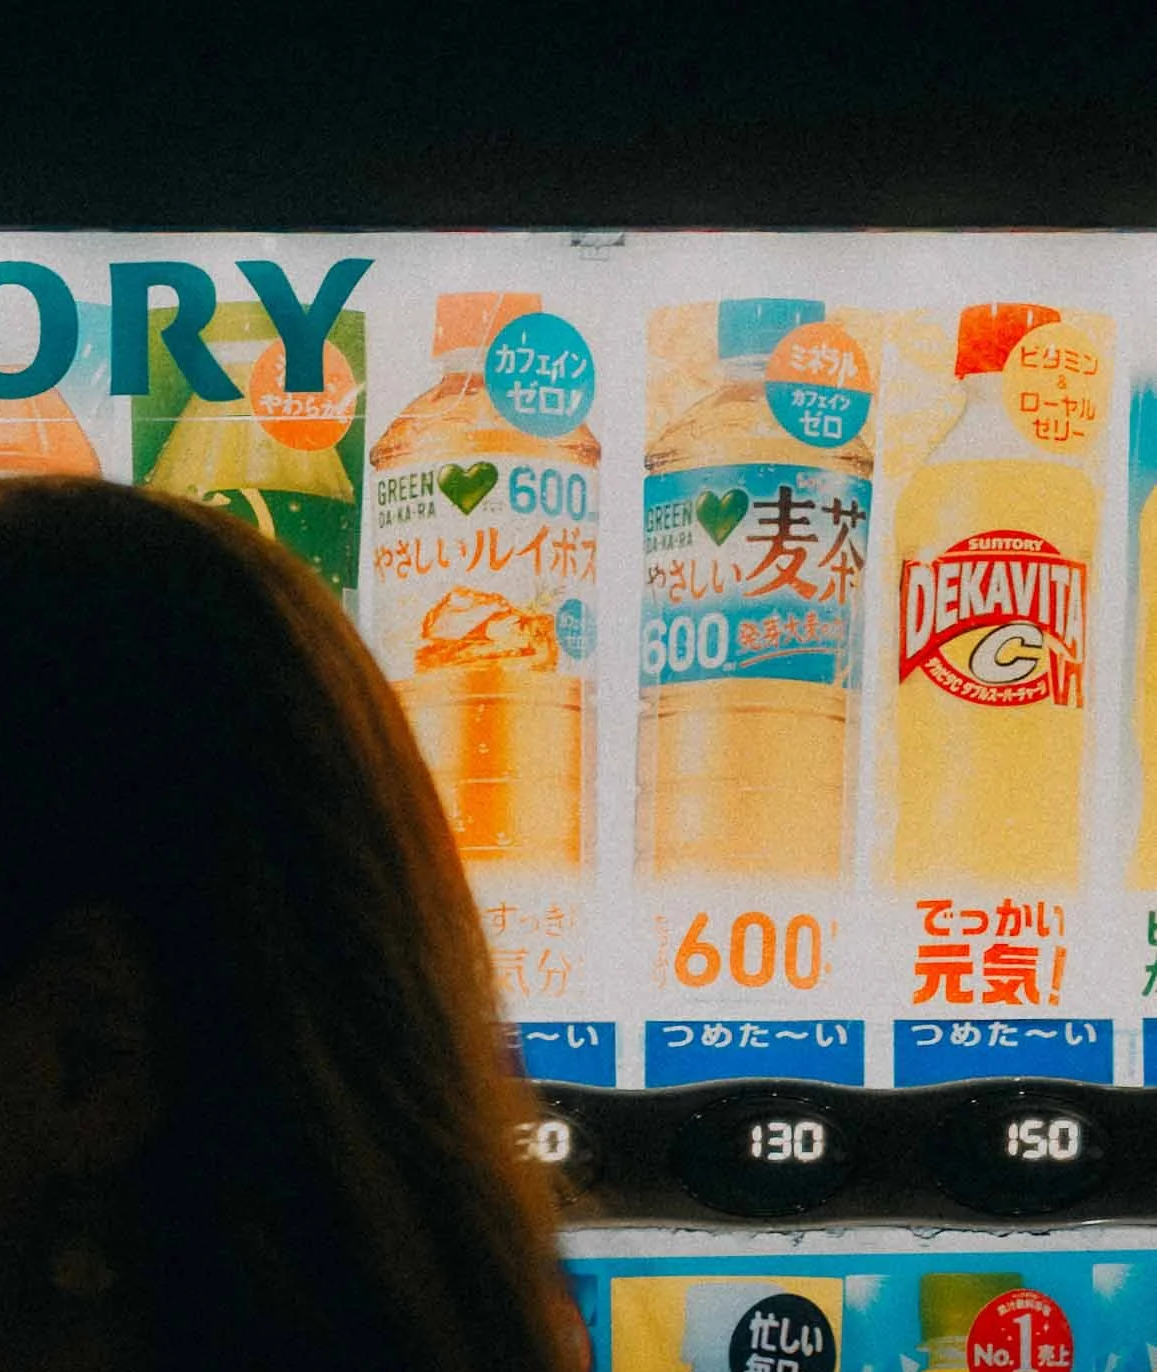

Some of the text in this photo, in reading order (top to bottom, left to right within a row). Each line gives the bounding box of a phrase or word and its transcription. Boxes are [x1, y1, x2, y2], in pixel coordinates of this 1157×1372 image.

[495, 344, 587, 384] カフェイン
[1019, 345, 1100, 376] ビタミン
[799, 411, 843, 440] ゼロ
[1019, 391, 1096, 421] ローヤル
[1031, 417, 1085, 442] ゼリー
[377, 465, 588, 522] GREEN 600
[645, 500, 694, 534] GREEN
[742, 484, 867, 606] 麦茶
[905, 560, 1084, 666] DEKAVITA
[641, 610, 730, 674] 600
[969, 621, 1045, 685] C
[915, 898, 1066, 939] でっかい
[673, 910, 824, 991] 600
[912, 943, 1069, 1008] 元気!
[751, 1120, 826, 1163] 130
[1007, 1120, 1082, 1162] 150
[747, 1309, 824, 1356] 忙しい
